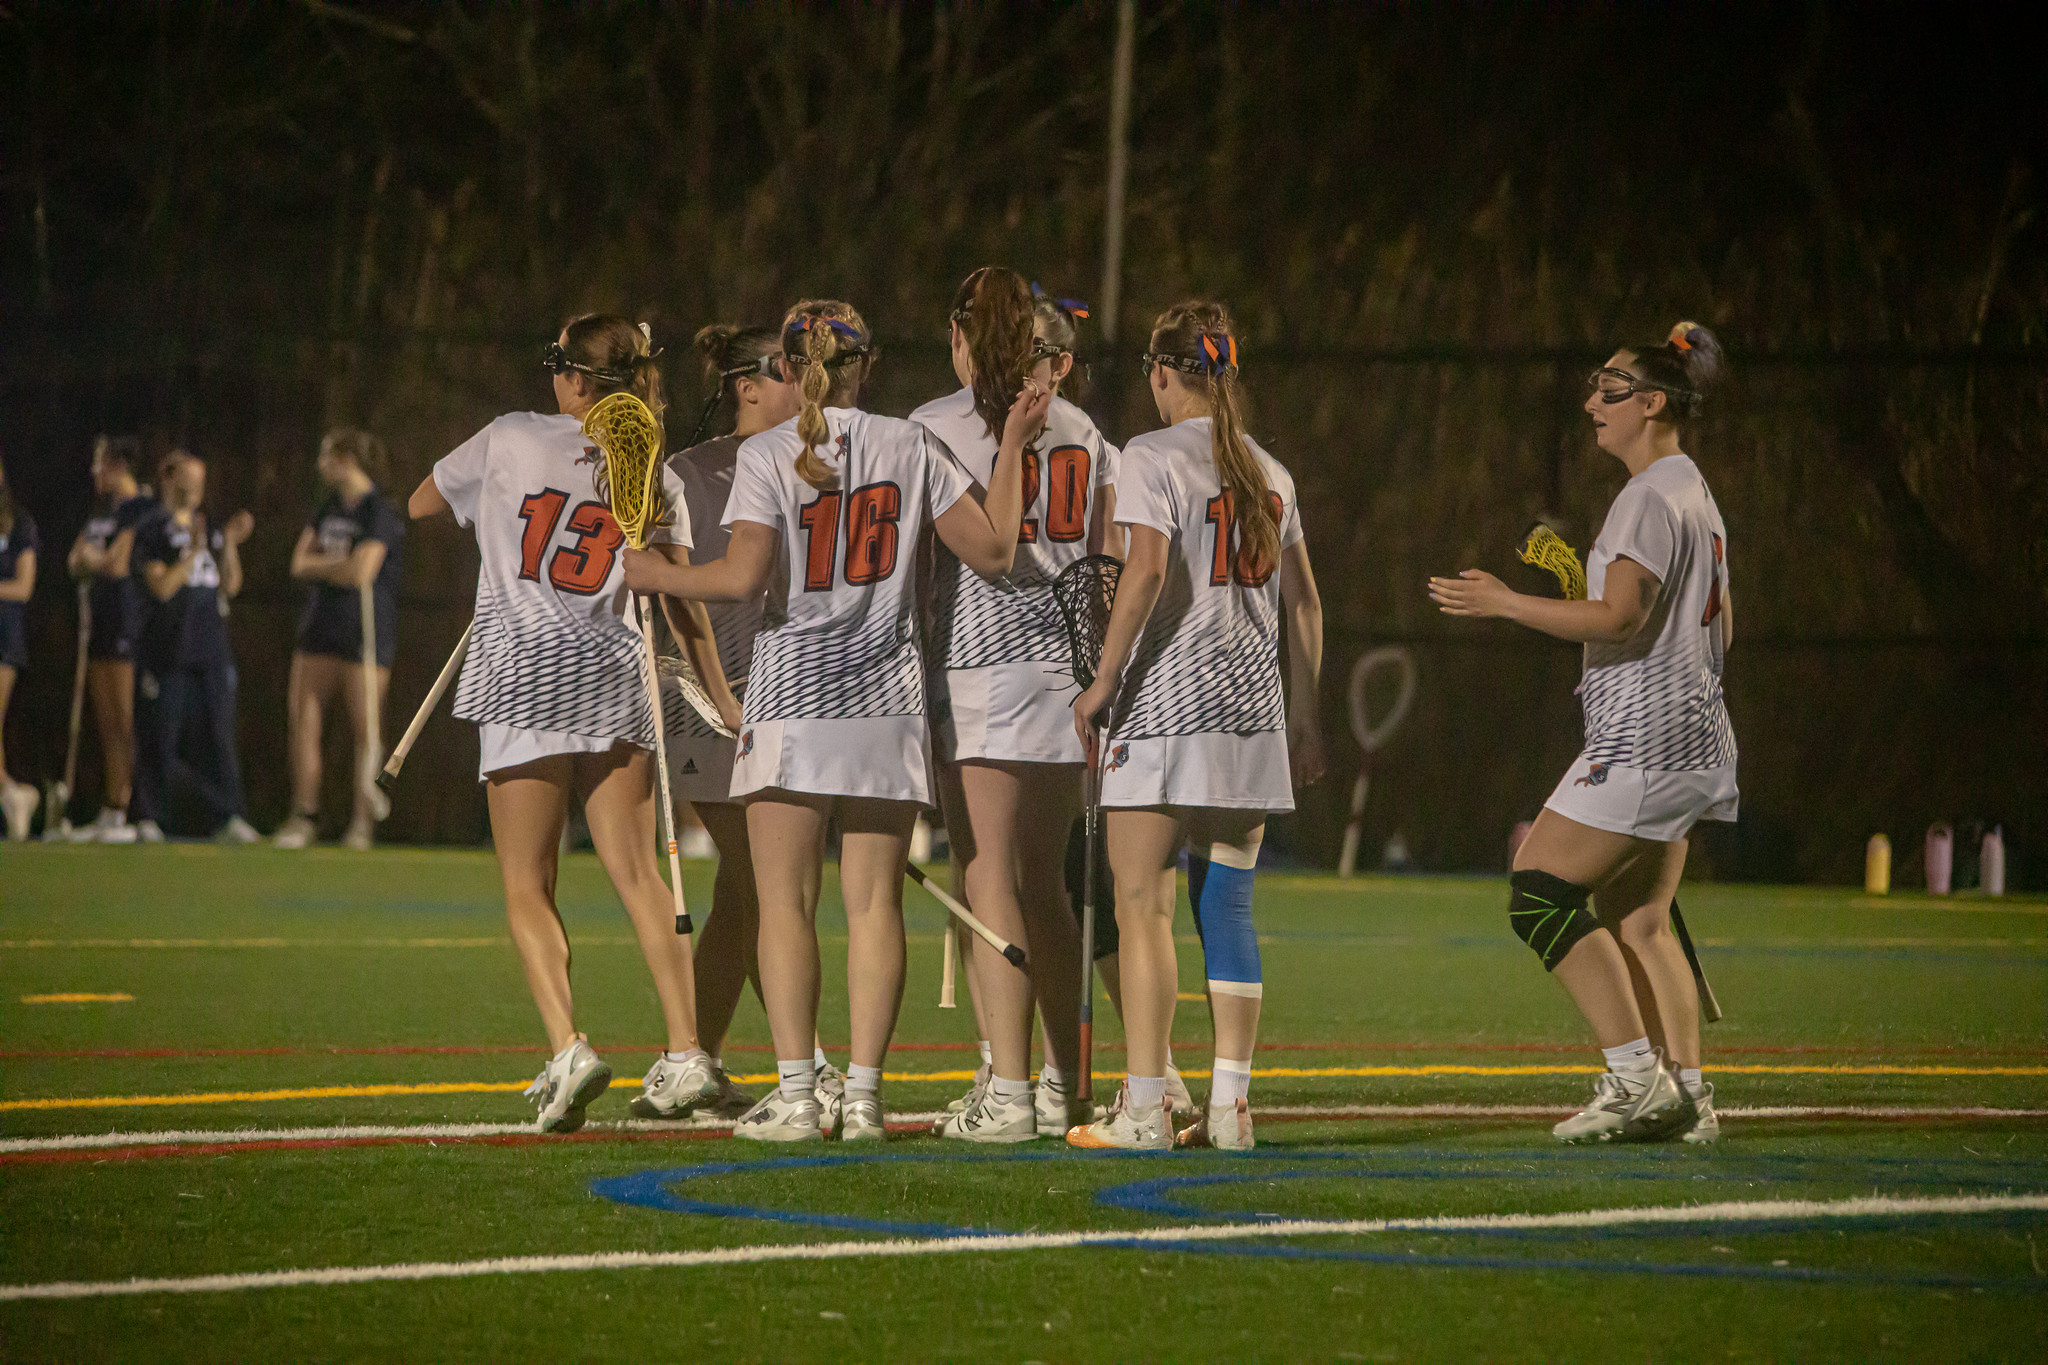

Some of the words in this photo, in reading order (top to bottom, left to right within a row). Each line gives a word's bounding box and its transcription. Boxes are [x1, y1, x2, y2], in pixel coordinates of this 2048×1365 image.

[790, 354, 811, 364] STX
[1156, 354, 1176, 364] STX
[1183, 358, 1203, 367] ST
[518, 486, 626, 597] 13
[799, 481, 902, 592] 16
